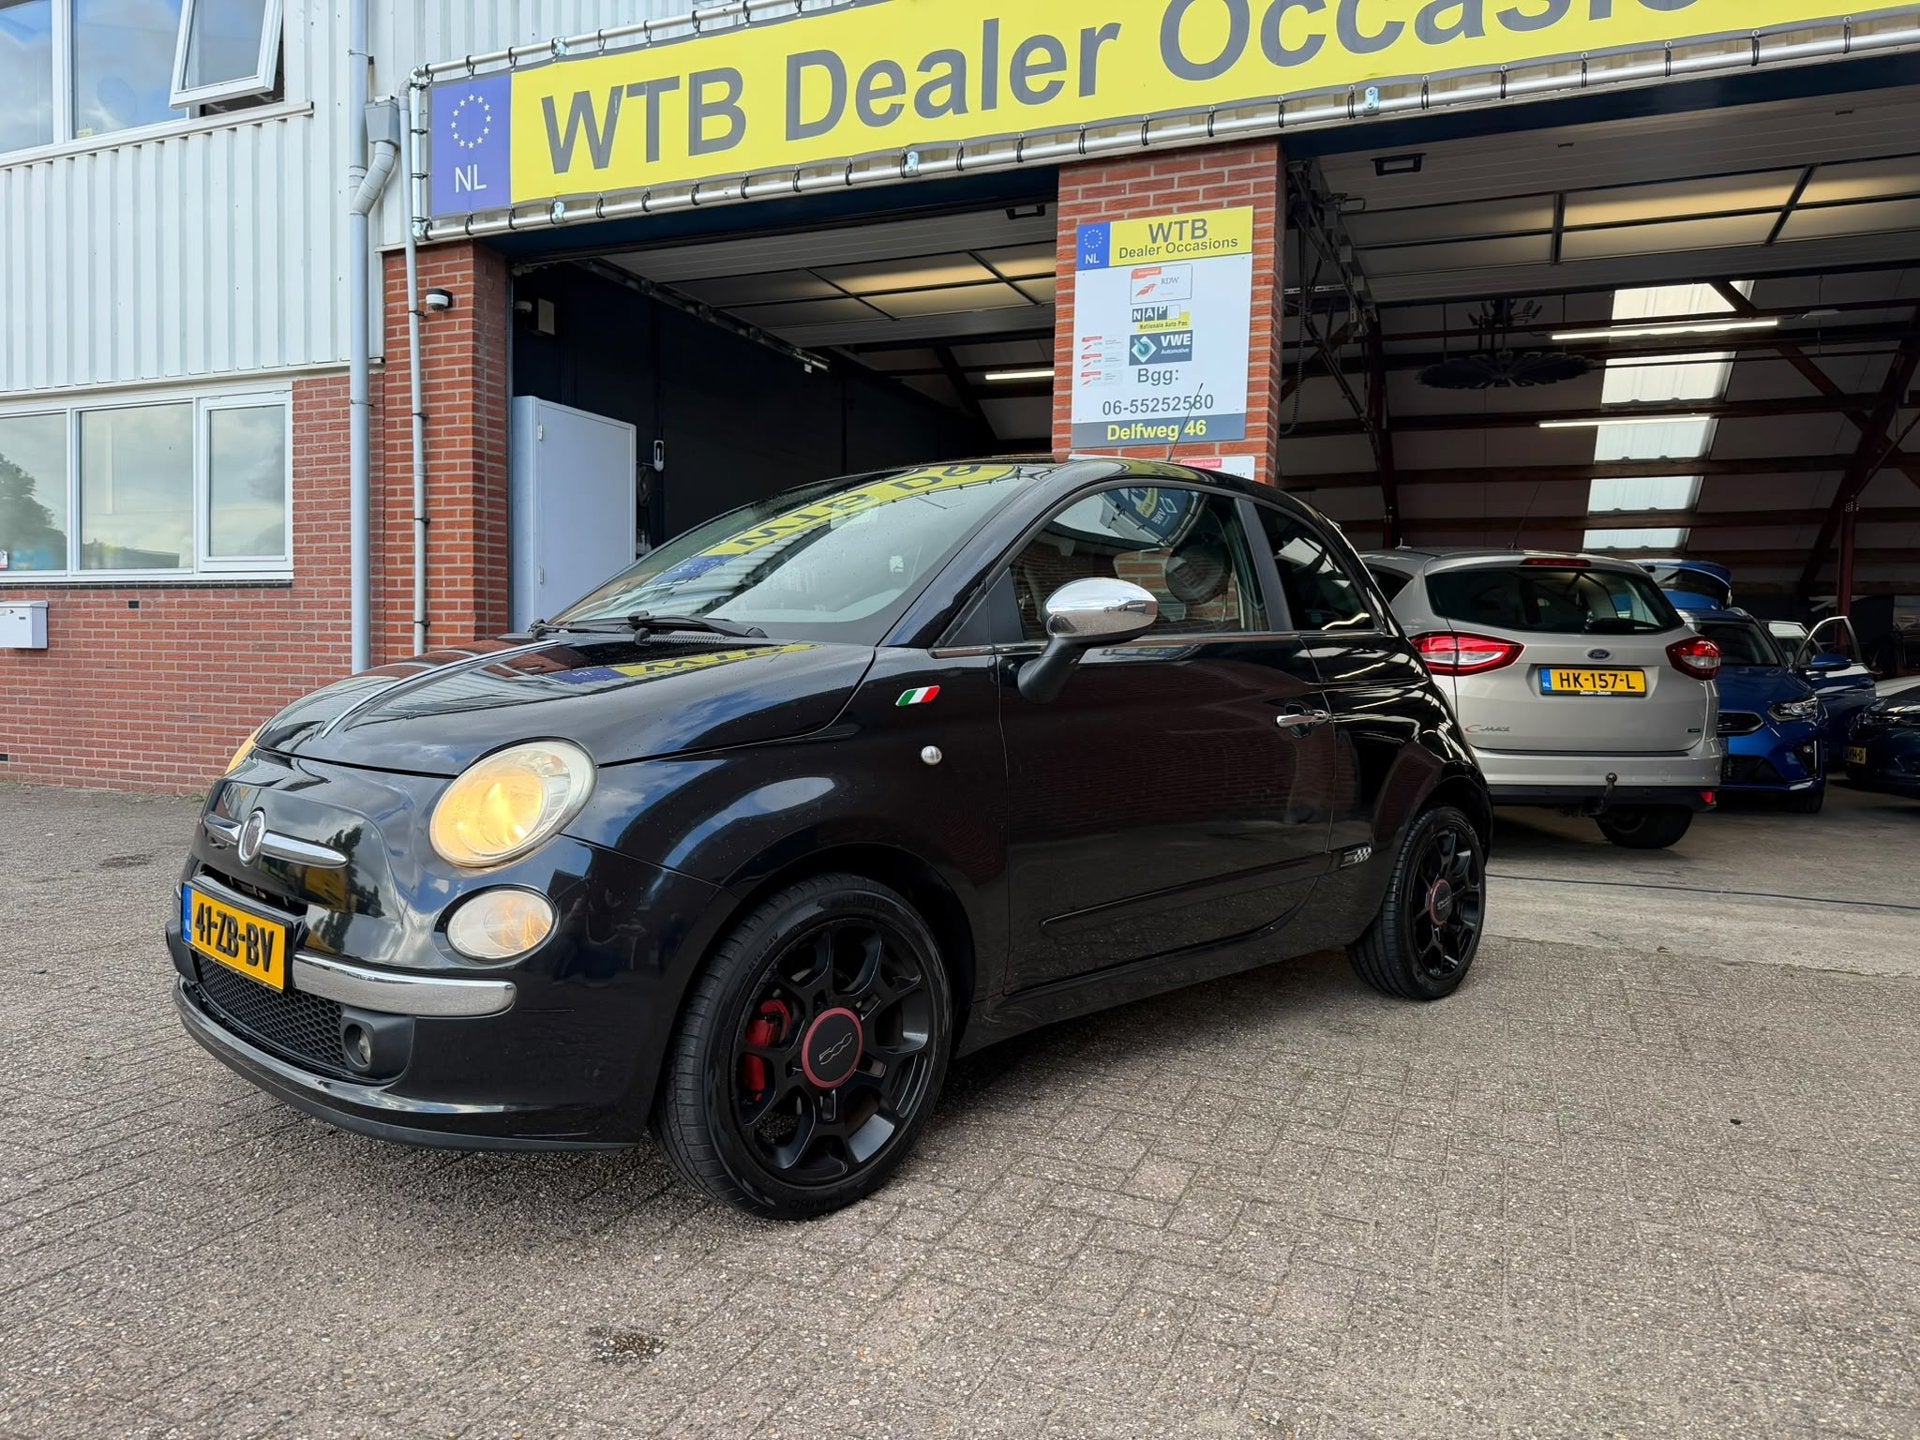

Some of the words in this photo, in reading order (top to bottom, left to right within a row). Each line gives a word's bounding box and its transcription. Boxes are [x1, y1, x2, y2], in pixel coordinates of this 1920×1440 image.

[541, 66, 747, 175] WTB
[785, 17, 1122, 141] Dealer
[455, 163, 487, 193] NL
[1148, 218, 1208, 244] WTB
[1085, 253, 1100, 265] NL
[1119, 244, 1162, 259] Dealer
[1165, 237, 1238, 254] Occasions
[1133, 304, 1167, 320] NAP
[1160, 333, 1191, 347] VWE
[1138, 368, 1179, 386] Bgg:
[1102, 394, 1214, 416] 06-55252580
[1107, 423, 1179, 442] Delfweg
[1184, 419, 1207, 436] 46
[1559, 672, 1636, 690] HK-157-L
[195, 902, 275, 973] 41-ZB-BV
